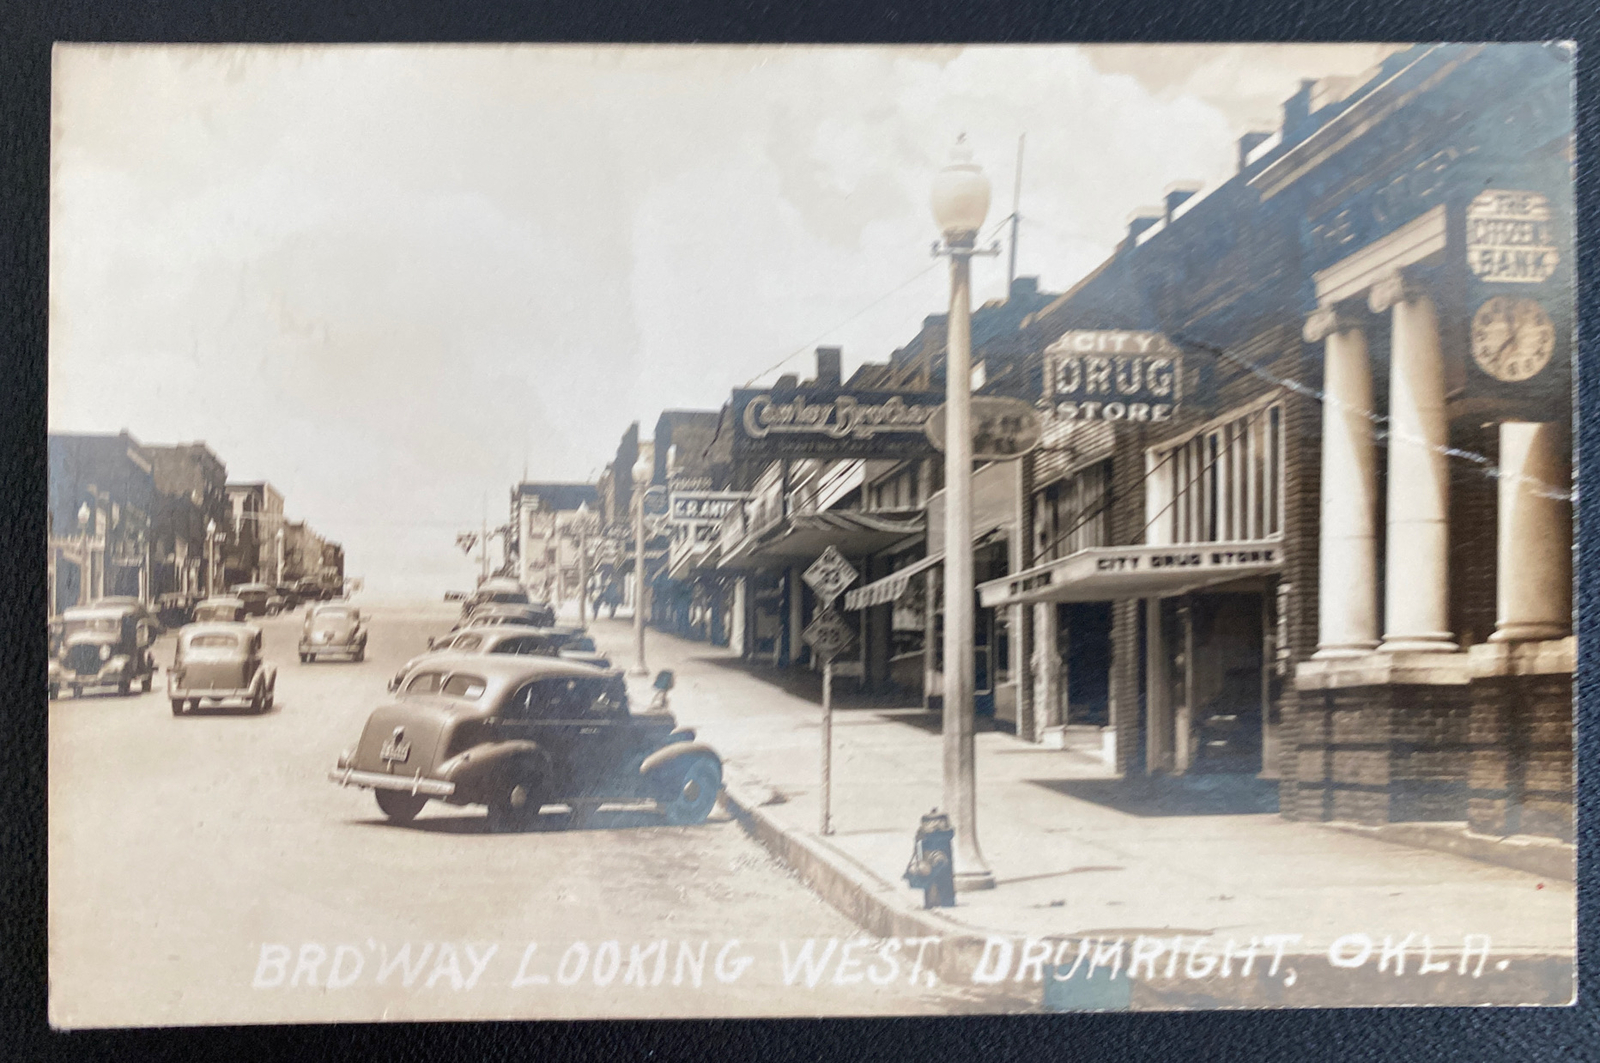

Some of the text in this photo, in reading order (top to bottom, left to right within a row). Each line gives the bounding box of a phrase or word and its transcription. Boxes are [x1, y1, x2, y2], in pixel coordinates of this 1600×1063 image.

[1074, 334, 1153, 352] CITY
[1056, 356, 1173, 396] DRUG
[1056, 401, 1172, 421] STORE
[1097, 550, 1274, 571] CITY DRUG STORE
